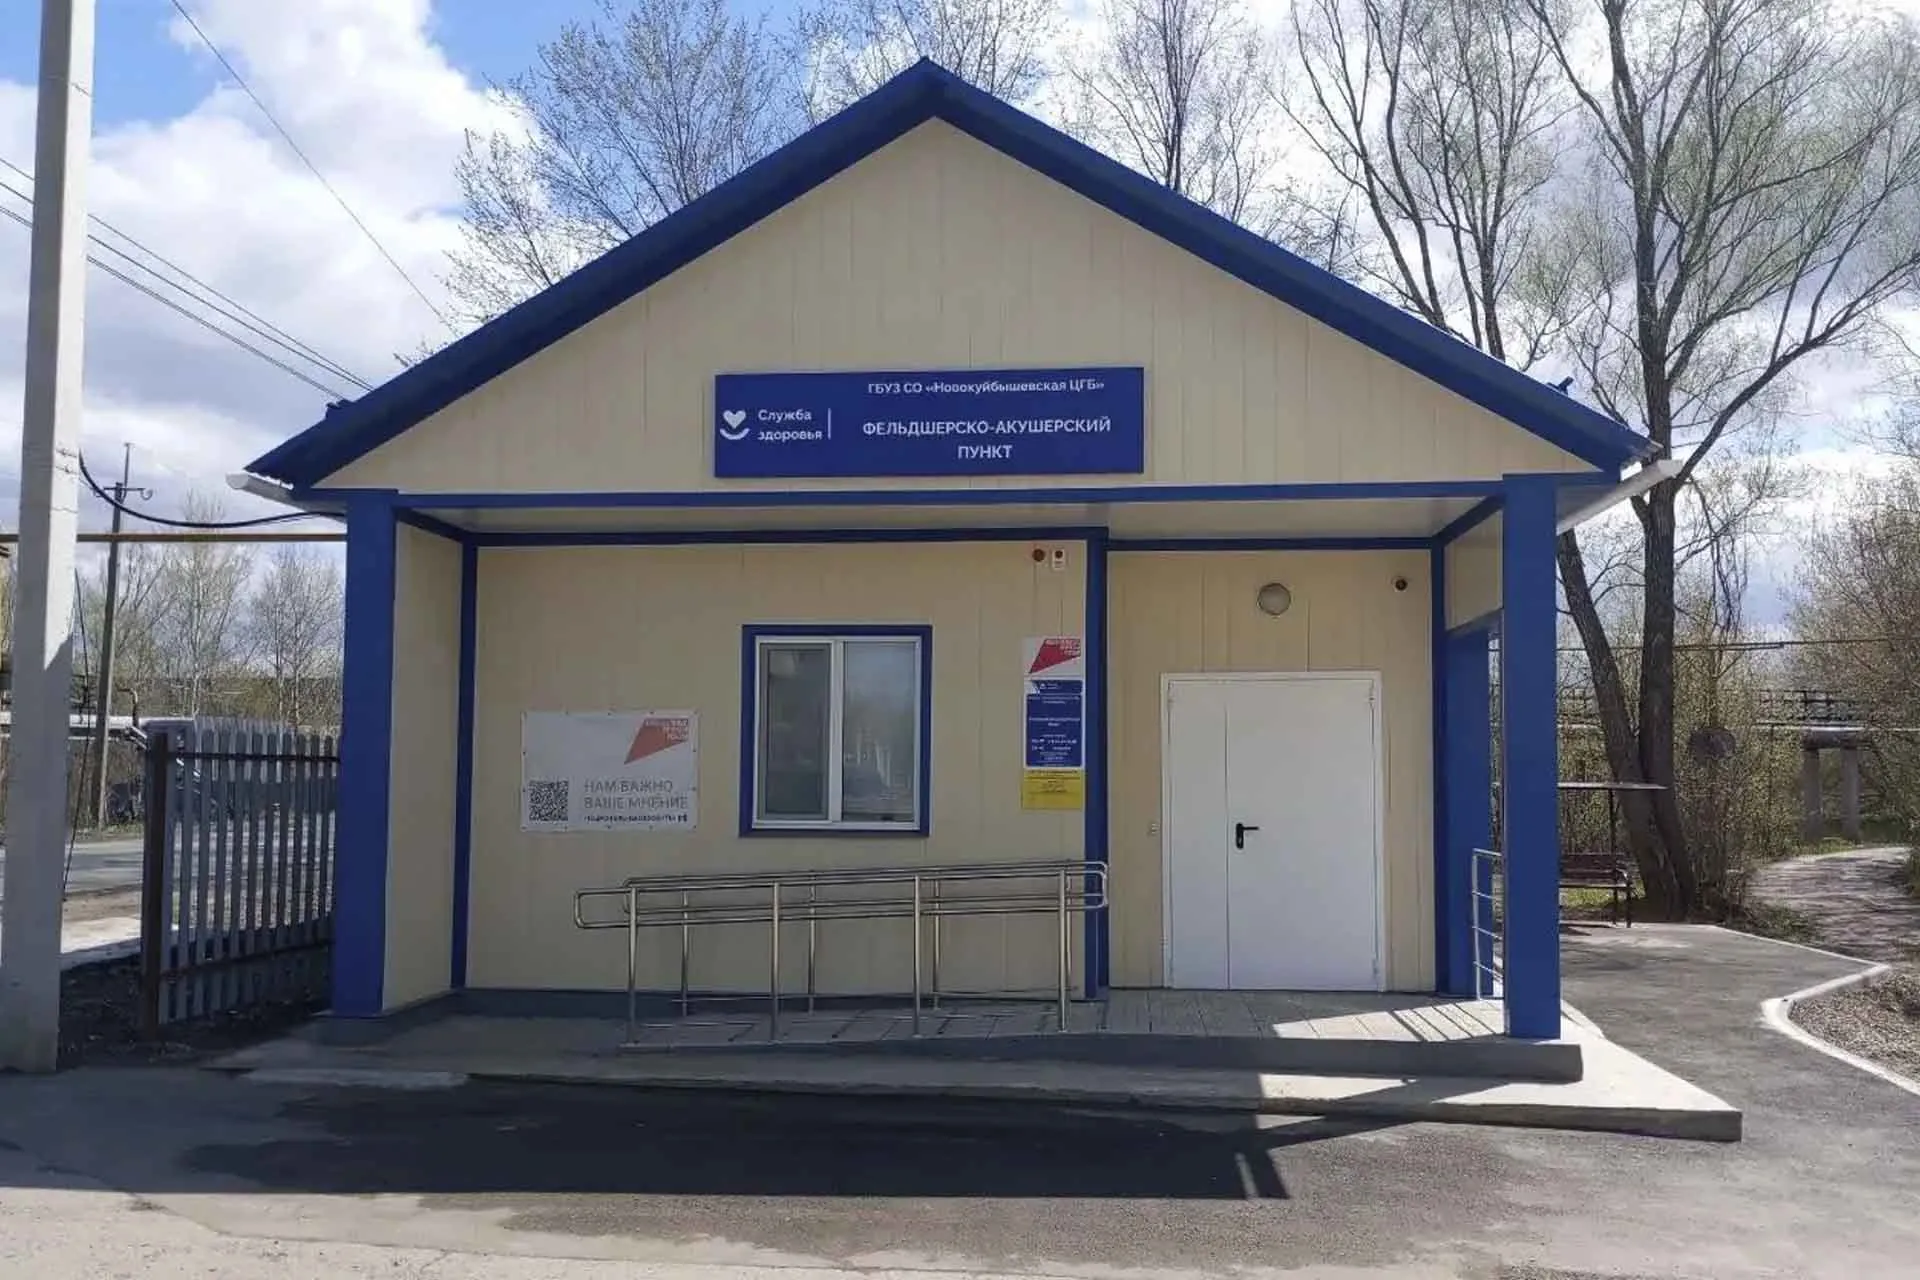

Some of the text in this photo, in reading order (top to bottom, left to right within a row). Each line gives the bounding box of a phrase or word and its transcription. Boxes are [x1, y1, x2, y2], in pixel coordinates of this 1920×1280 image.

[868, 379, 1105, 395] ГБУЗ СО «Новокуйбышевская ЦГБ»
[758, 408, 812, 423] Служба
[863, 415, 1111, 437] ФЕЛЬДШЕРСКО-АКУШЕРСКИЙ
[757, 430, 823, 443] здоровья
[958, 445, 1012, 459] ПУНКТ
[584, 779, 616, 793] НАМ
[584, 796, 688, 810] ВАШЕ МНЕНИЕ
